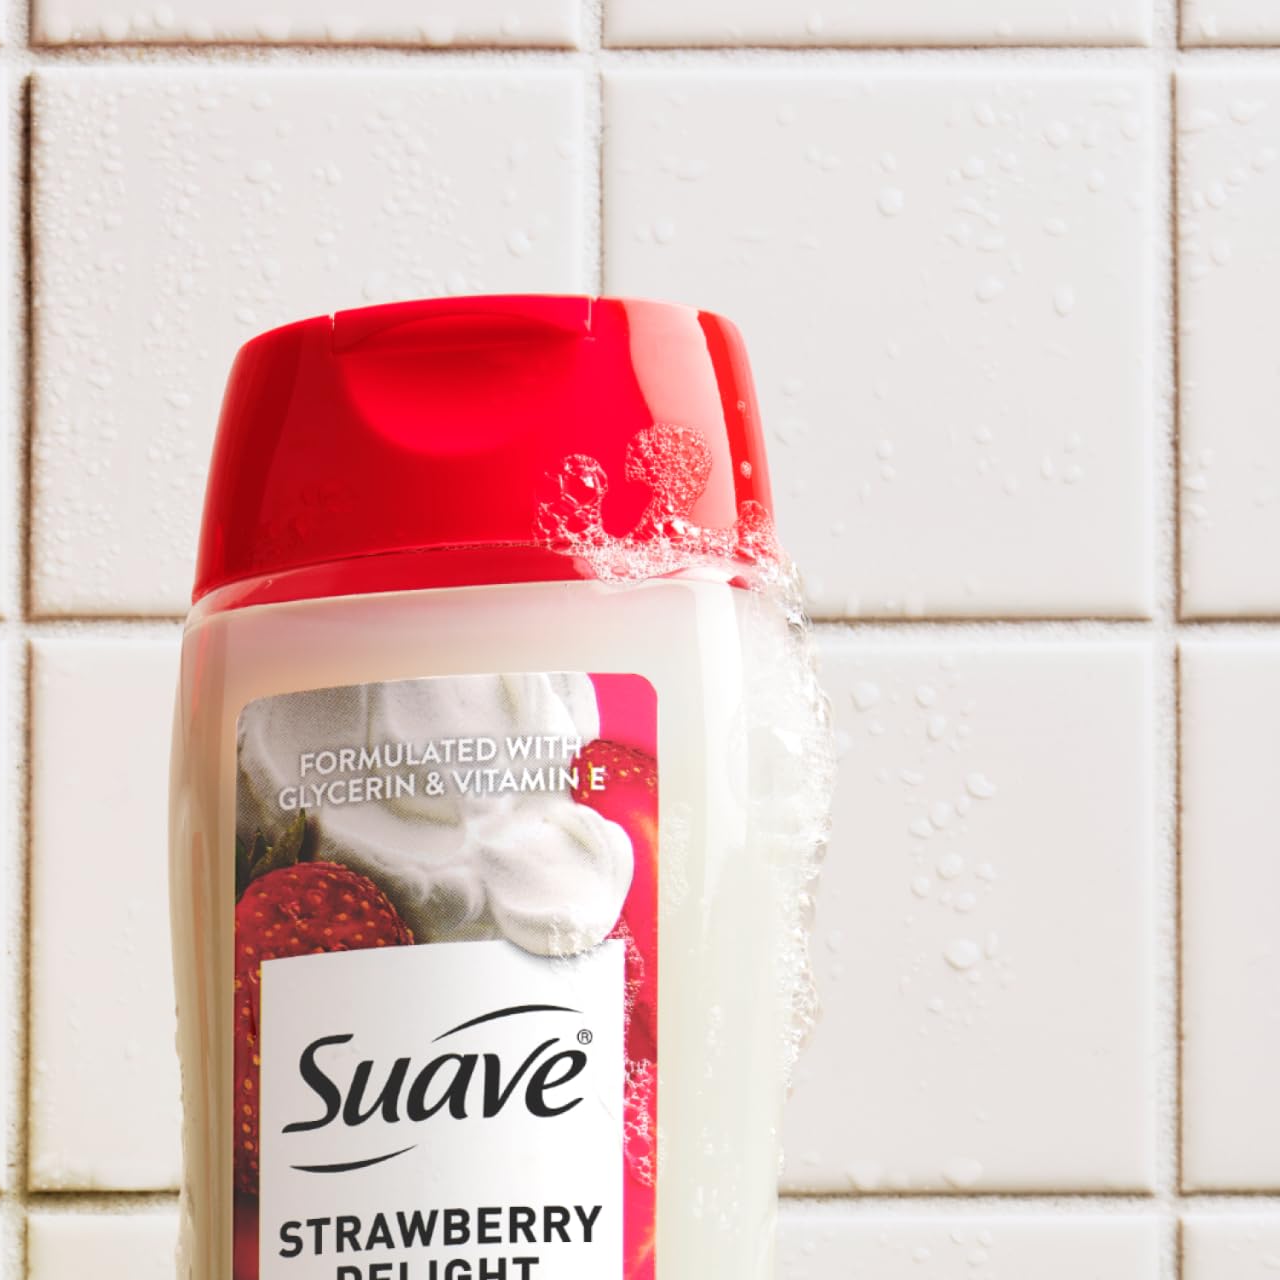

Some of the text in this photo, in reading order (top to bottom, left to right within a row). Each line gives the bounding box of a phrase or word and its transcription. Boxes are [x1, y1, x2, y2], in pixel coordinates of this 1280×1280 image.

[300, 735, 582, 778] FORMULATED WITH
[279, 766, 606, 811] GLYCERIN & VITAMIN E
[279, 1205, 602, 1258] STRAWBERRY
